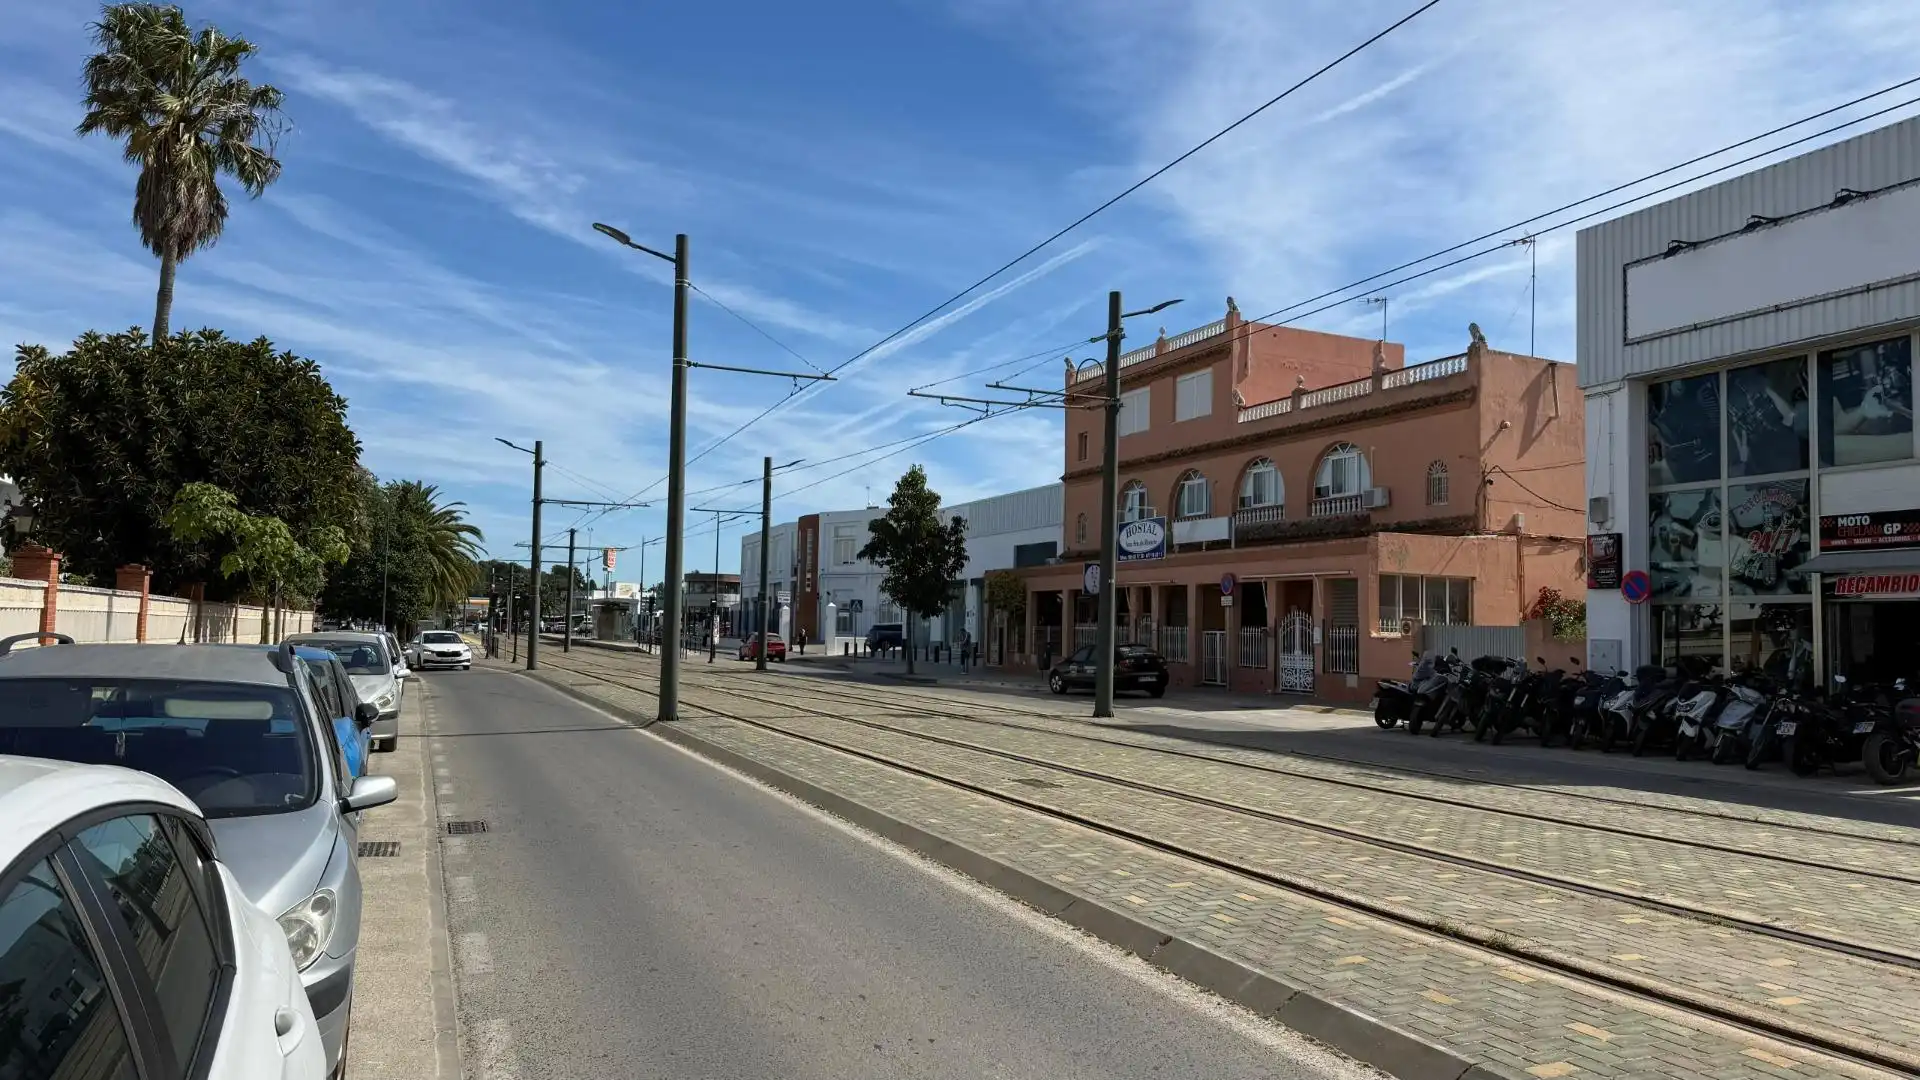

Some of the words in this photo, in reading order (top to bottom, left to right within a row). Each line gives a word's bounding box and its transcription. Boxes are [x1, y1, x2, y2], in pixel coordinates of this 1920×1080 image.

[1838, 515, 1870, 527] MOTO
[1126, 523, 1157, 538] HOSTAL
[1883, 523, 1902, 535] GP
[1747, 529, 1793, 553] 24/7
[1835, 575, 1920, 594] RECAMBIO
